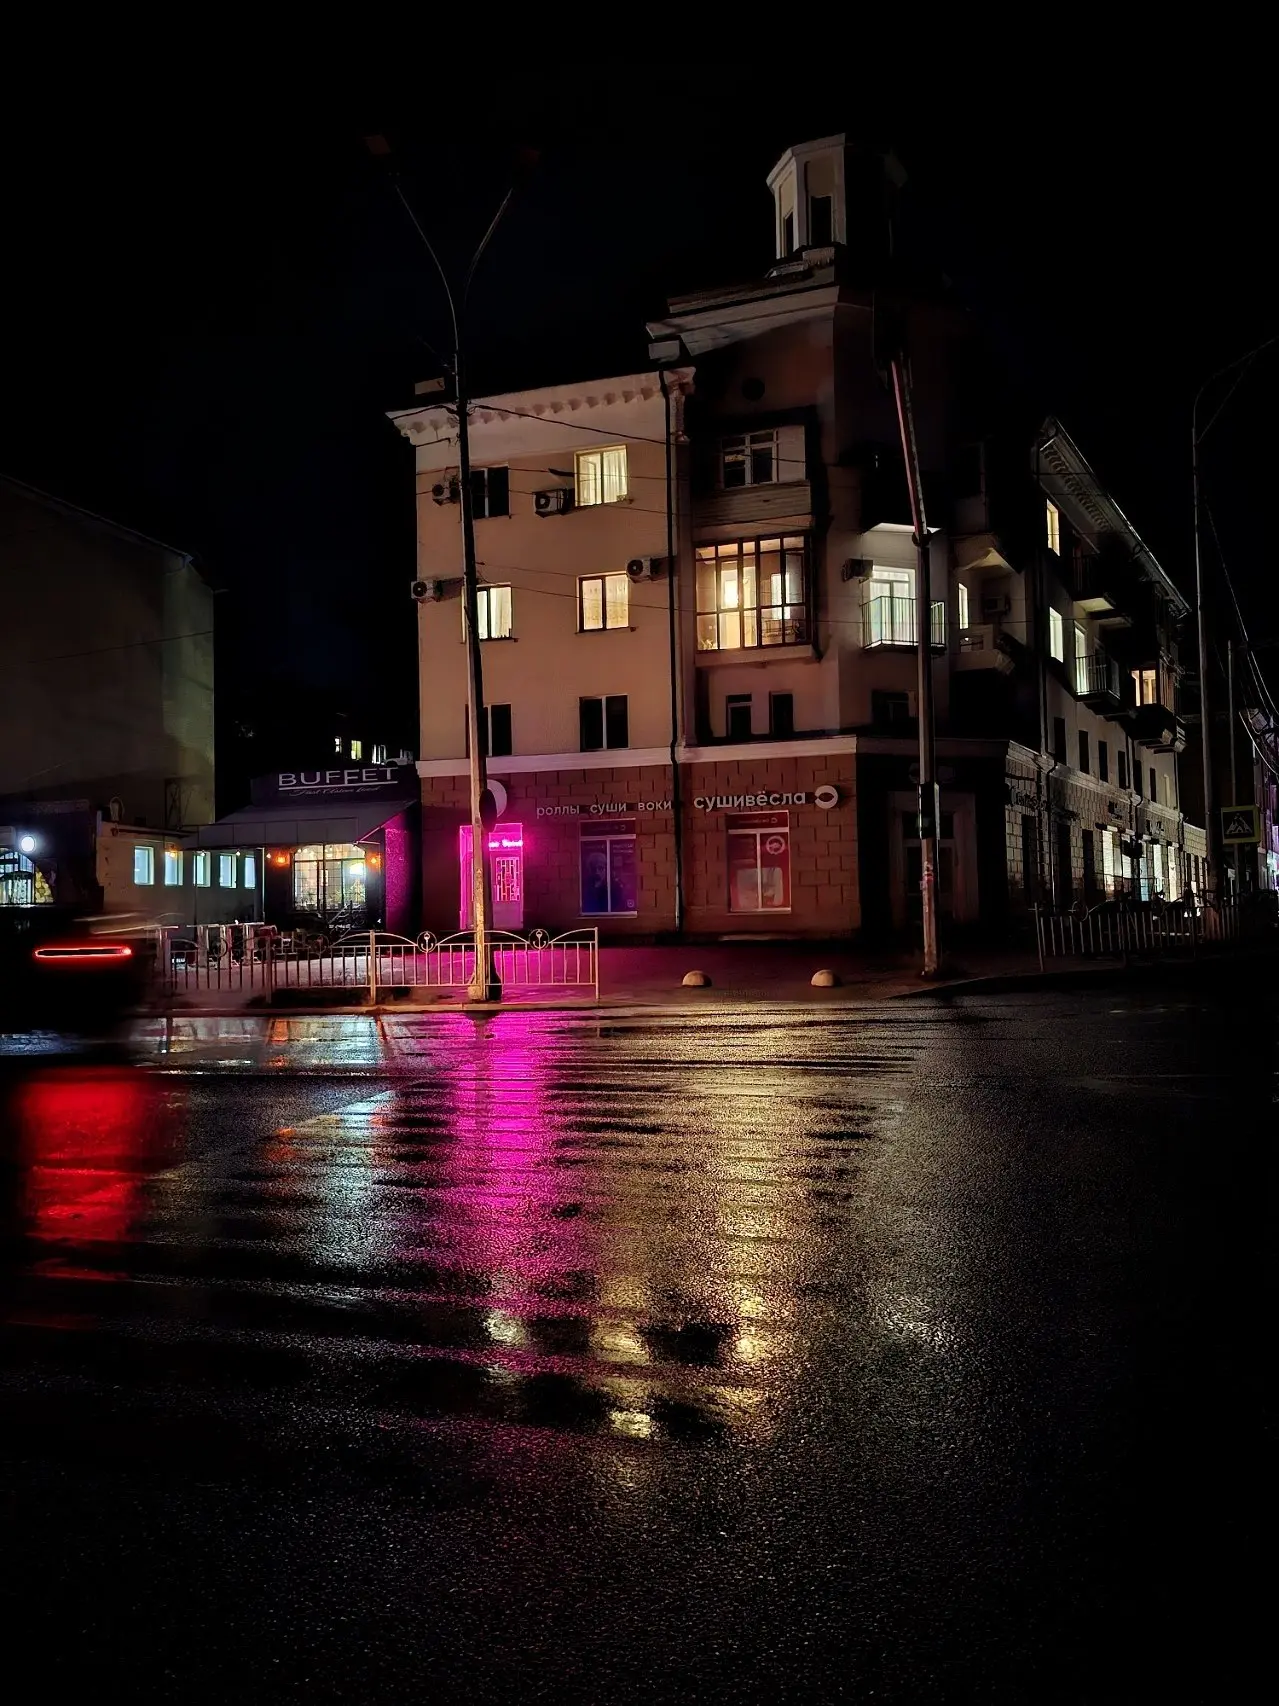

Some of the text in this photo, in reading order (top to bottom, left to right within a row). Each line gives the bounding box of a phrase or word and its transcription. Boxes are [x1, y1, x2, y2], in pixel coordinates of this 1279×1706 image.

[278, 767, 399, 786] BUFFET
[536, 800, 672, 819] роллы суши воки
[693, 790, 806, 813] сушивёсла
